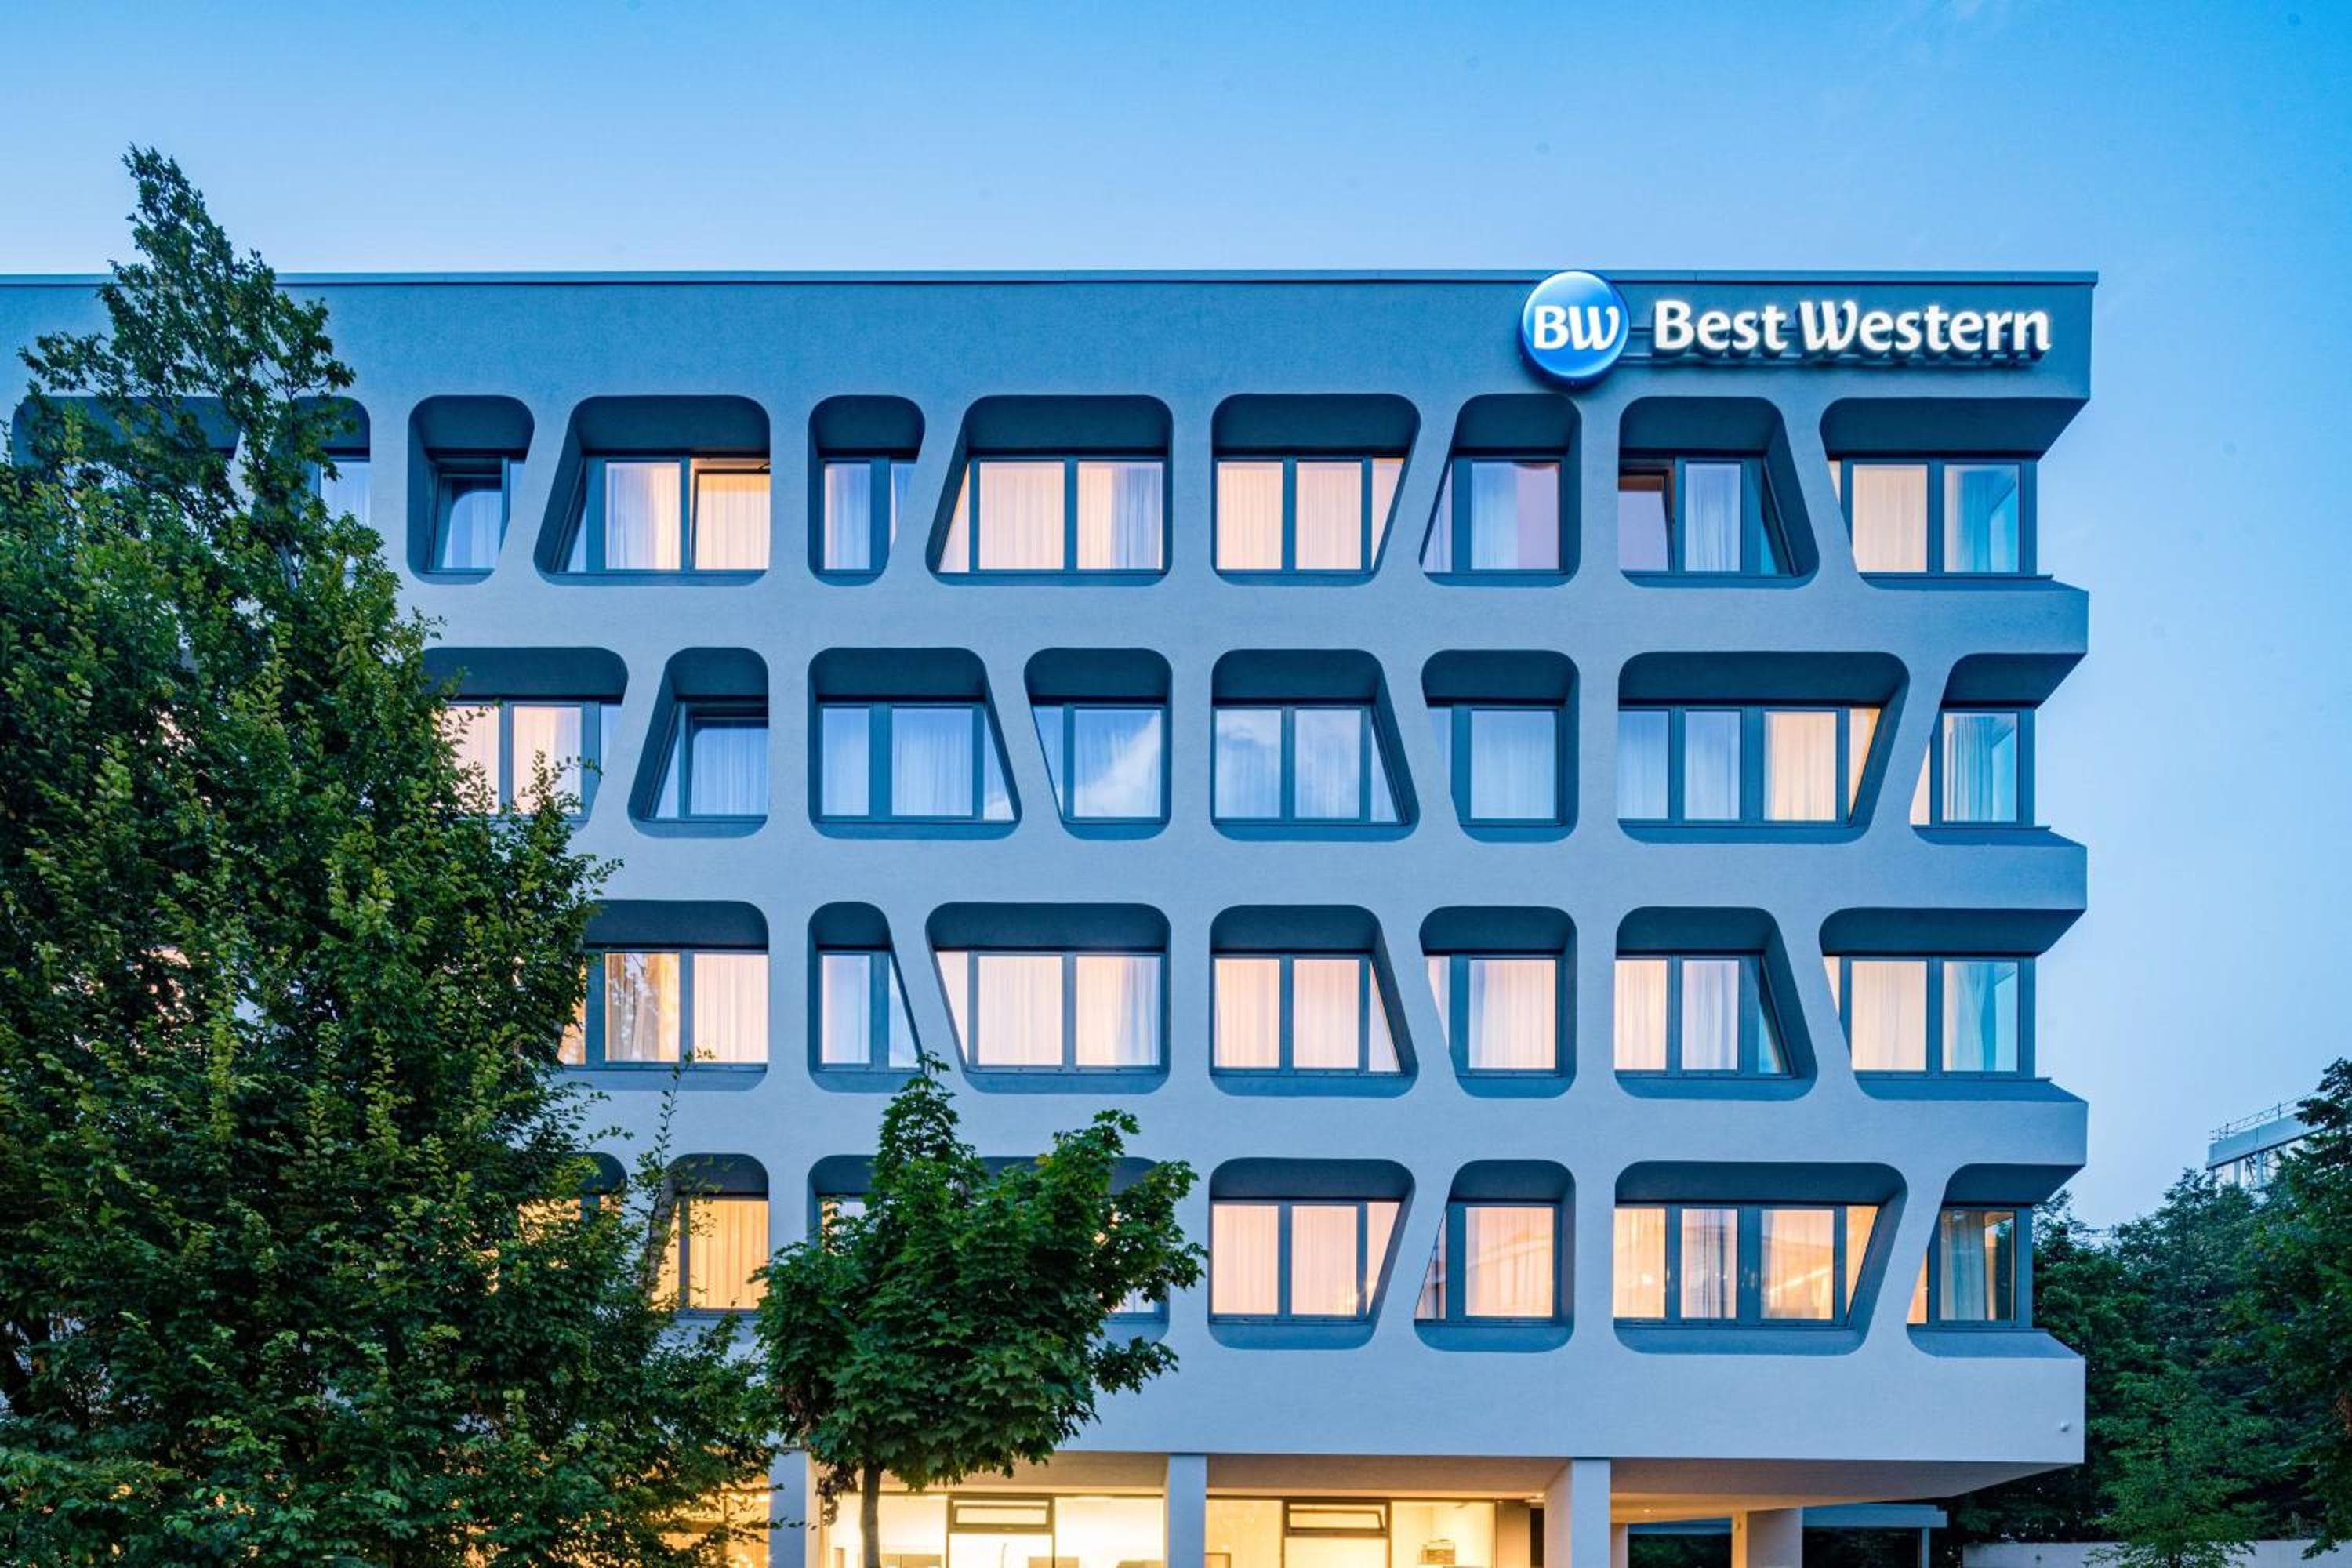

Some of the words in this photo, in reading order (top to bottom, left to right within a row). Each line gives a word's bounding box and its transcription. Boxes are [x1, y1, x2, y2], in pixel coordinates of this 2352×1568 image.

[1533, 304, 1621, 351] BW
[1653, 300, 1788, 351] Best
[1800, 300, 2052, 352] Western
